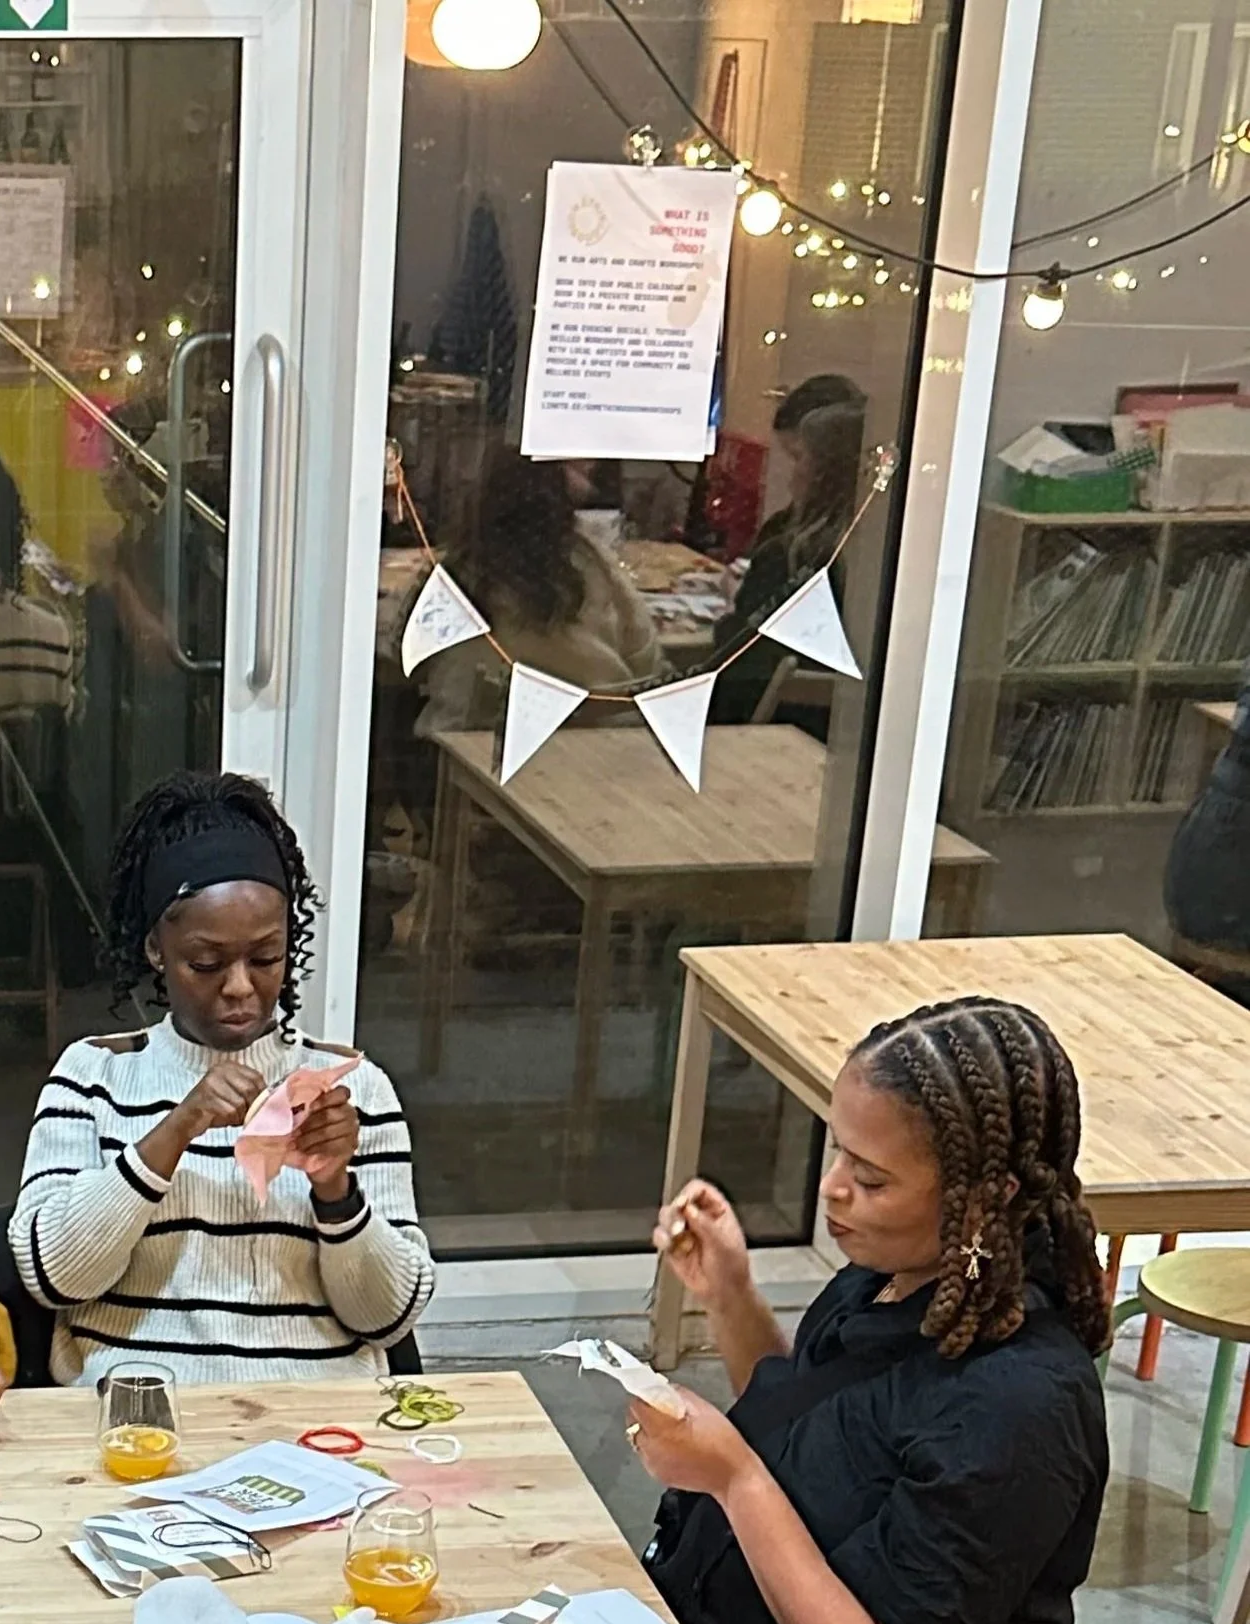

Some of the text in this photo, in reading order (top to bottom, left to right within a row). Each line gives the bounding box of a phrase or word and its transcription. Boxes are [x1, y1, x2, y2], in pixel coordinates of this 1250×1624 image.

[664, 209, 709, 221] WHAT IS
[649, 225, 707, 238] SOMETHING
[672, 242, 704, 254] GOOD?
[557, 255, 567, 263] WE
[588, 256, 607, 265] ARTS
[610, 257, 625, 266] AND
[627, 258, 656, 267] CRAFTS
[577, 279, 596, 287] INTO
[599, 280, 613, 288] OUR
[616, 281, 644, 289] PUBLIC
[597, 291, 629, 300] PRIVATE
[588, 302, 603, 310] FOR
[618, 304, 646, 312] PEOPLE
[550, 323, 559, 331] WE
[580, 324, 613, 333] EVENING
[549, 335, 580, 343] SKILLED
[595, 348, 627, 356] ARTISTS
[647, 350, 674, 358] GROUPS
[545, 357, 577, 365] PROVIDE
[590, 359, 611, 367] SPACE
[632, 361, 673, 369] COMMUNITY
[676, 362, 690, 370] AND
[544, 368, 580, 376] WELLNESS
